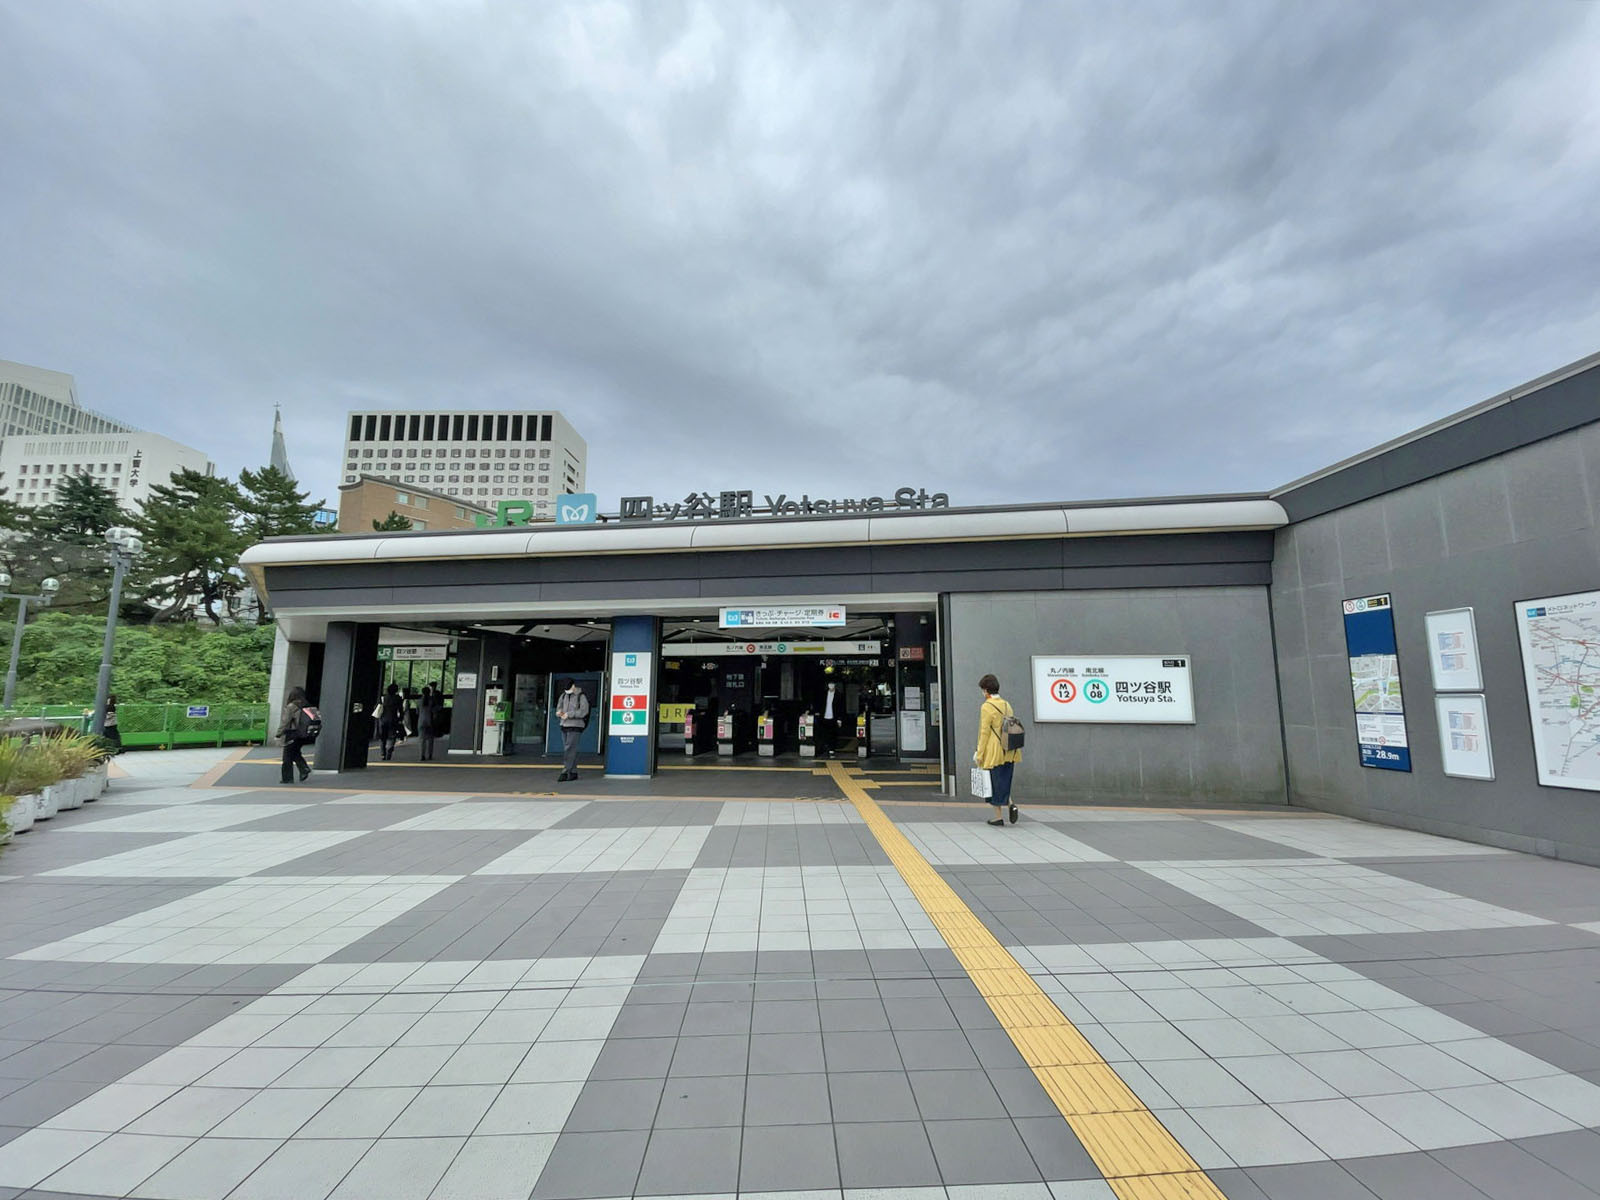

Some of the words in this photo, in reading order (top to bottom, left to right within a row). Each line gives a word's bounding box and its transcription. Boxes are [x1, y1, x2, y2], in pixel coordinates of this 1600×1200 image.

[620, 490, 753, 521] 四ツ谷駅
[895, 487, 949, 510] Sta
[378, 648, 392, 656] JR
[1115, 681, 1171, 694] 四ツ谷駅
[1090, 691, 1103, 699] 08
[1117, 695, 1155, 704] Yotsuya
[1157, 695, 1176, 703] Sta.
[1375, 749, 1400, 760] 28.9m
